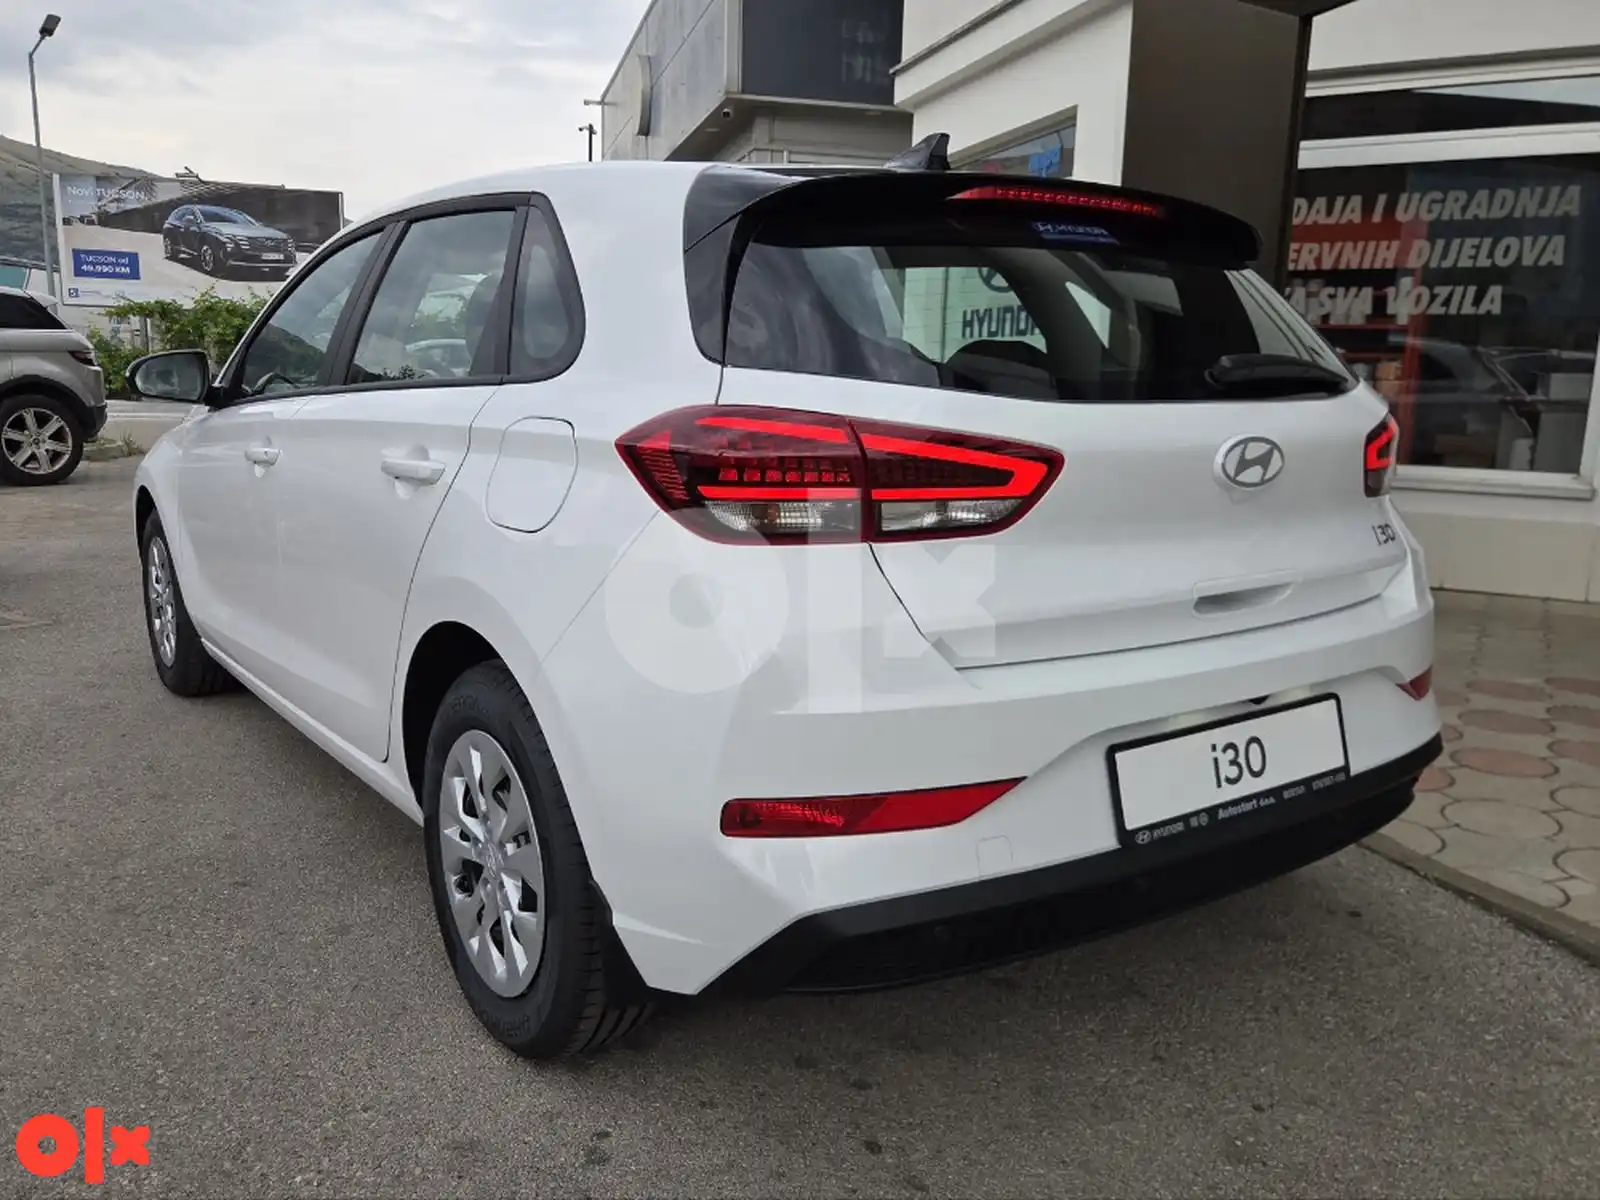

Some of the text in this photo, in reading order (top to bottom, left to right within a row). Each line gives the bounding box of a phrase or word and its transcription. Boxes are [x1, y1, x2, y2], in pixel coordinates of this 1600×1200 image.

[1371, 194, 1387, 223] I
[1395, 185, 1582, 223] UGRADNJA
[1287, 234, 1566, 271] ERVNIH DIJELOVA
[1319, 286, 1374, 316] SVA
[1386, 284, 1504, 316] VOZILA
[1210, 735, 1267, 789] i30
